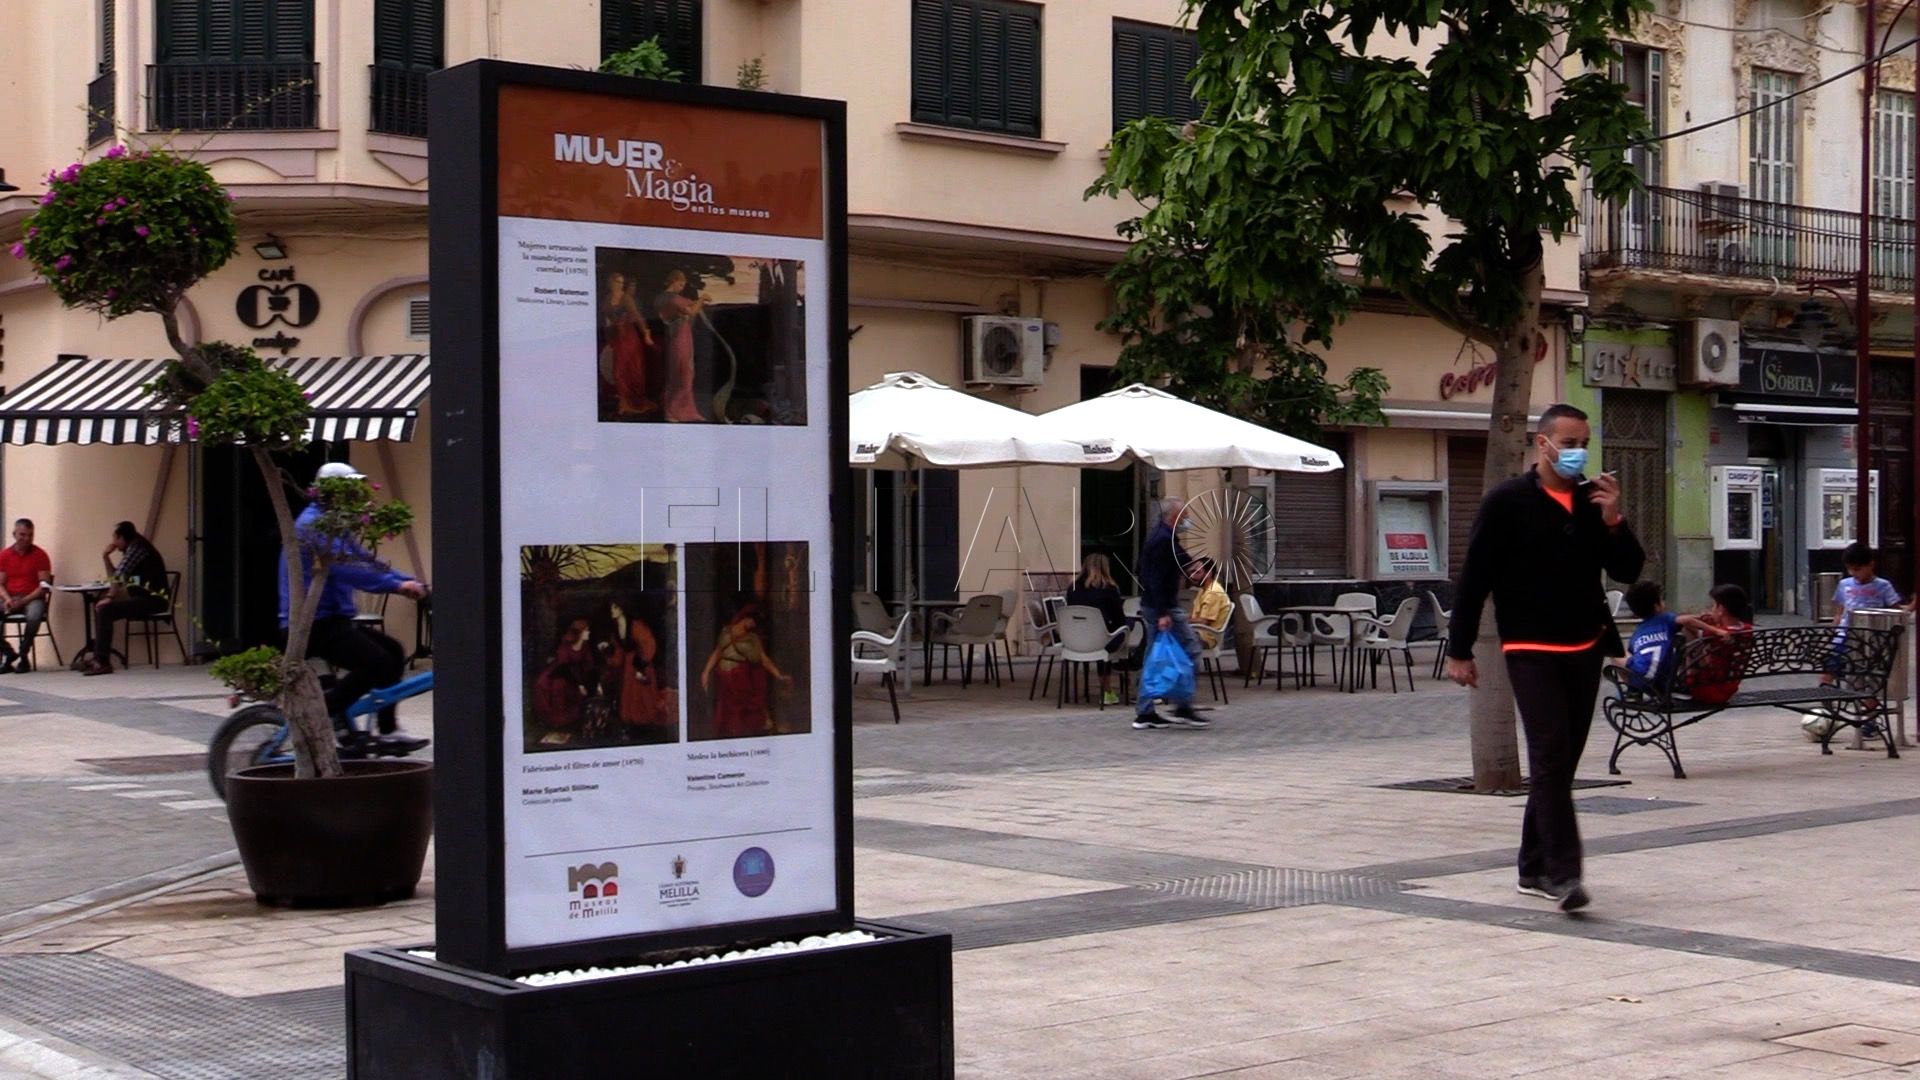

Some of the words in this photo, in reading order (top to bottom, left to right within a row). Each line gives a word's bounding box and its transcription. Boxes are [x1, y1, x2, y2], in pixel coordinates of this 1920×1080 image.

[554, 133, 664, 170] MUJER
[625, 168, 714, 211] Magia
[691, 205, 705, 214] en
[708, 205, 725, 215] los
[729, 208, 770, 218] museos
[1640, 645, 1662, 679] 7
[660, 887, 700, 899] MELILLA
